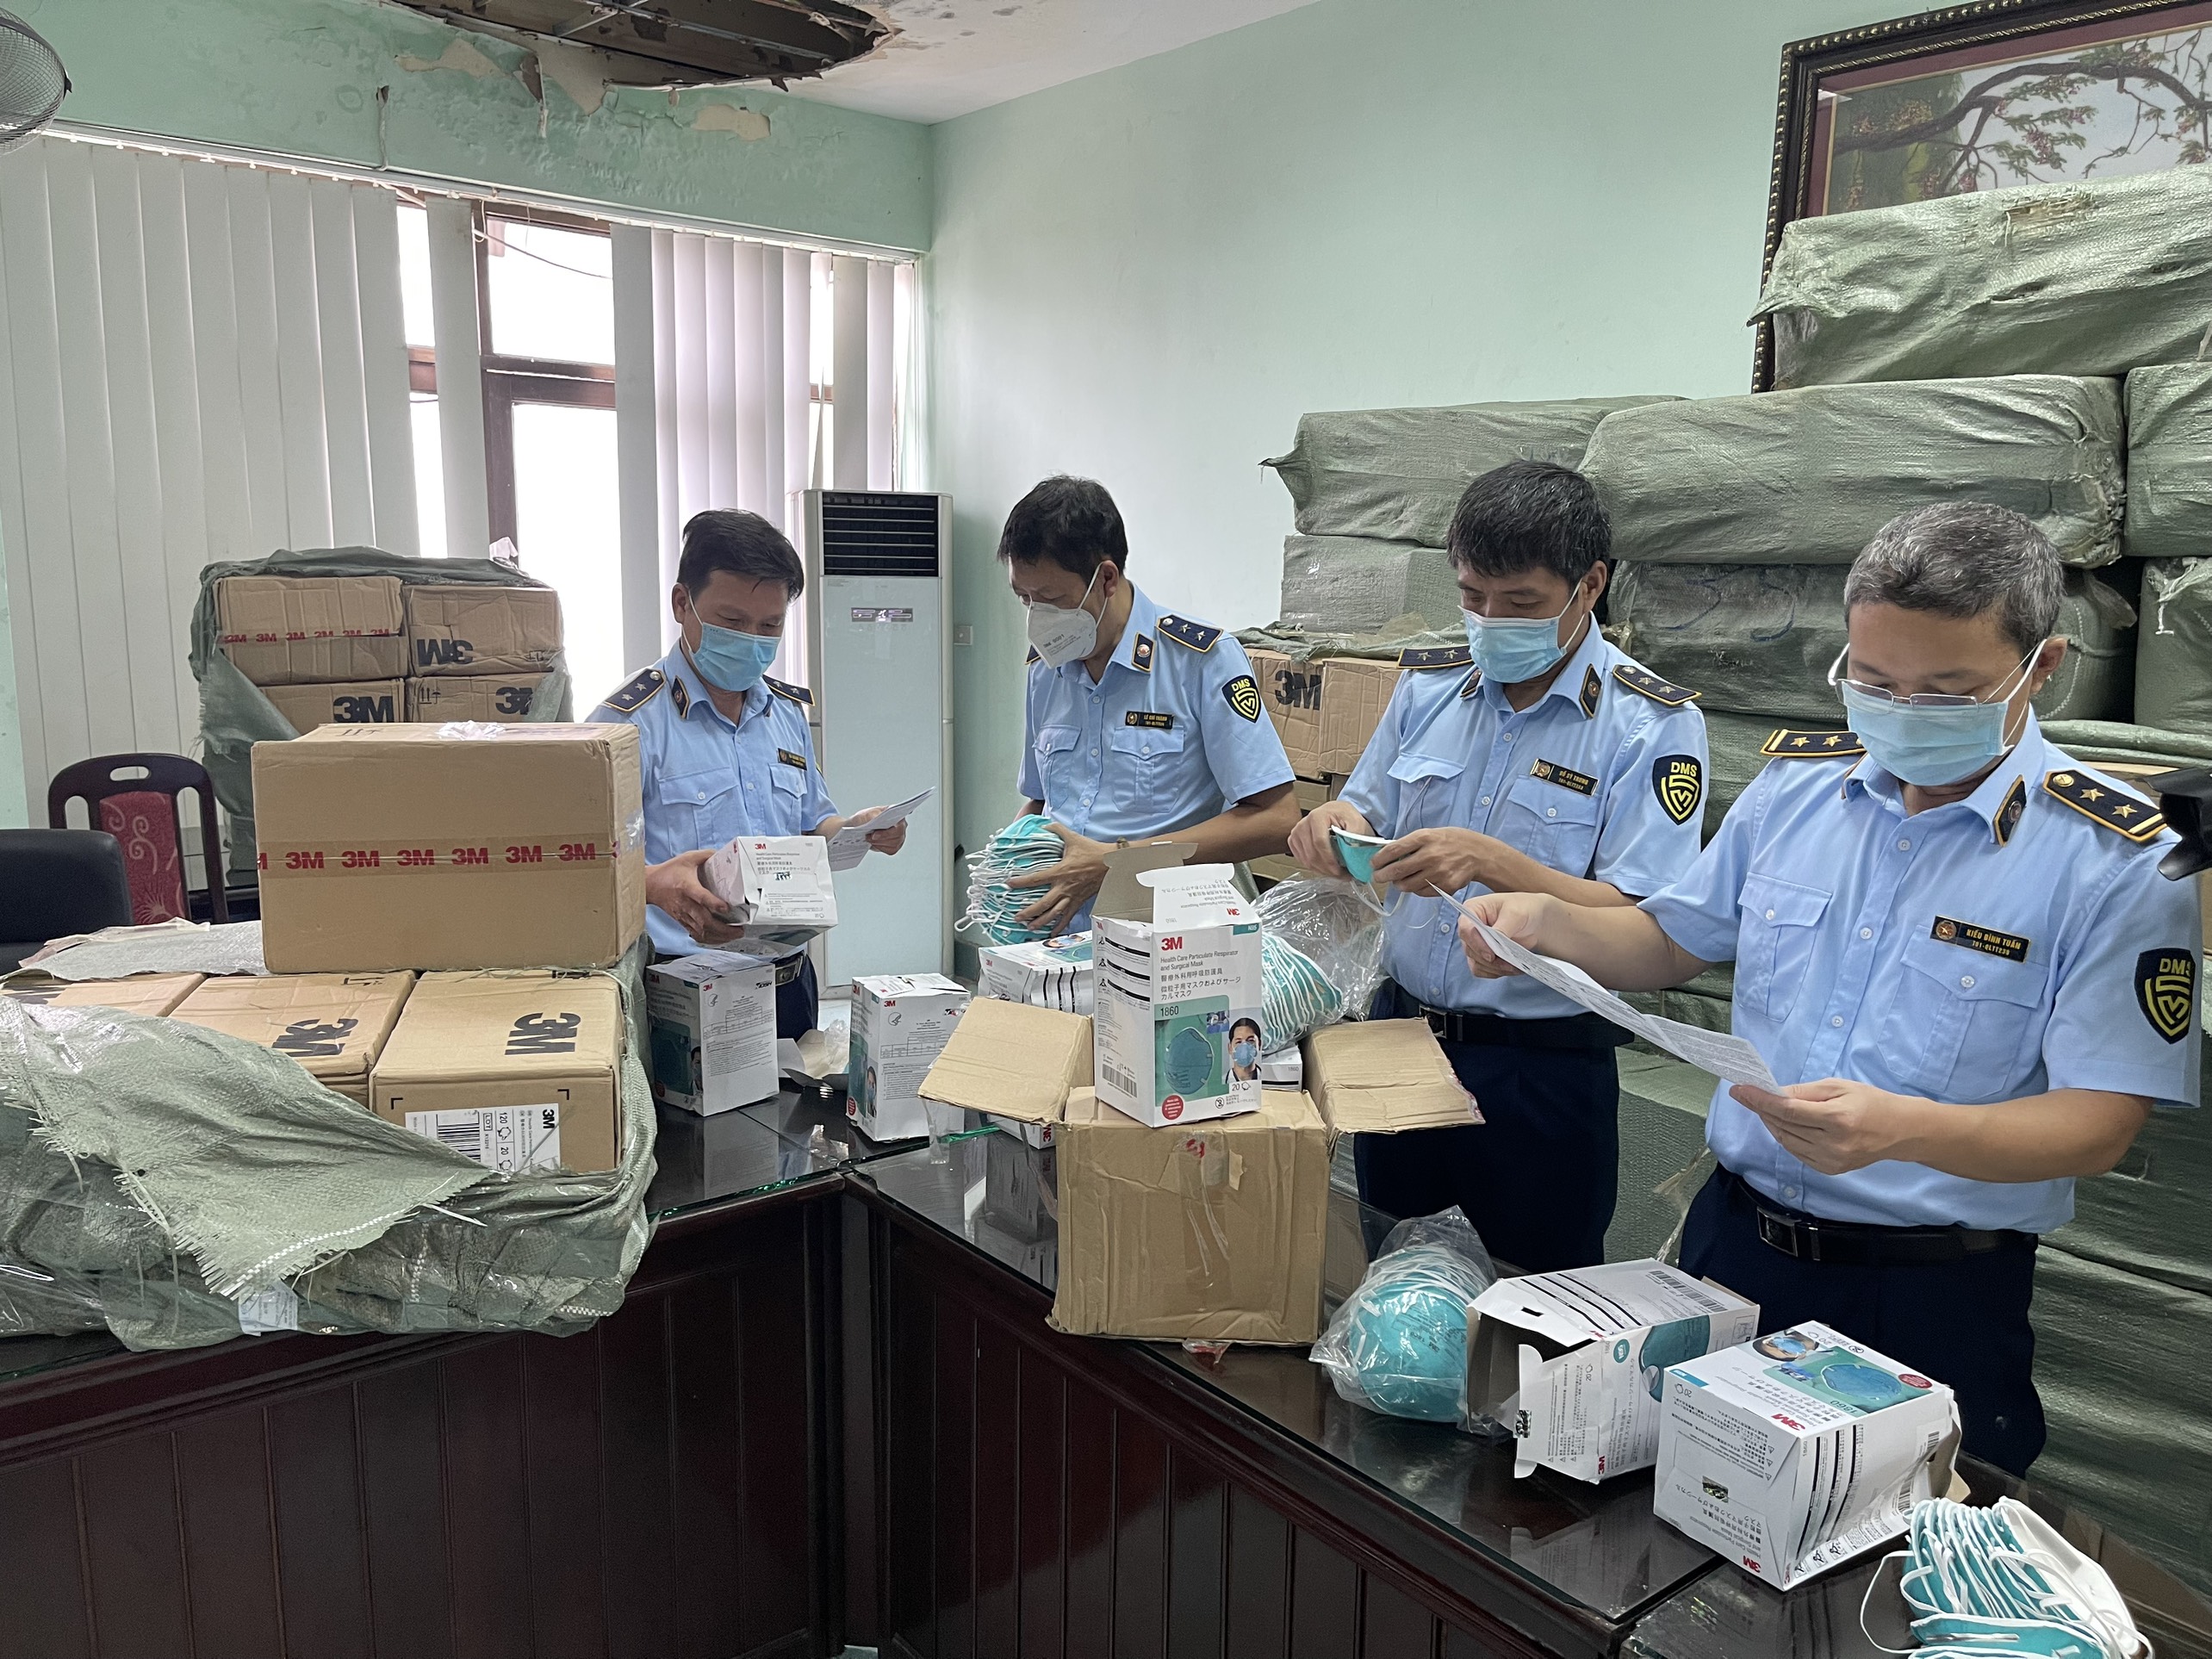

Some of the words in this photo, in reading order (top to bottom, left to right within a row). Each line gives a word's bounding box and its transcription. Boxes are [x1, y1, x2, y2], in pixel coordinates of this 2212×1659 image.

[256, 633, 277, 643] 3M
[286, 631, 306, 641] 3M
[416, 638, 474, 668] 3M
[1231, 678, 1251, 692] DMS
[1274, 669, 1322, 711] 3M
[332, 695, 395, 724] 3M
[1670, 761, 1697, 777] DMS
[285, 851, 325, 869] 3M
[341, 850, 380, 867] 3M
[397, 849, 435, 867] 3M
[451, 848, 488, 865] 3M
[506, 846, 543, 863] 3M
[559, 843, 596, 861] 3M
[1227, 907, 1240, 916] 3M
[1161, 936, 1183, 951] 3M
[1189, 951, 1214, 960] Particulate
[985, 959, 993, 967] 3M
[1171, 962, 1190, 972] Surgical
[703, 983, 713, 991] 3M
[852, 985, 861, 996] 3M
[1160, 1005, 1179, 1017] 1860
[271, 1018, 359, 1058] 3M
[505, 1012, 581, 1056] 3M
[1232, 1083, 1240, 1091] 20
[499, 1112, 508, 1124] 120
[542, 1109, 556, 1129] 3M
[500, 1146, 509, 1155] 20
[1684, 1389, 1693, 1397] 20
[1830, 1400, 1858, 1414] 1860
[1770, 1413, 1806, 1432] 3M
[1598, 1455, 1606, 1475] 3M
[1743, 1556, 1762, 1574] 3M
